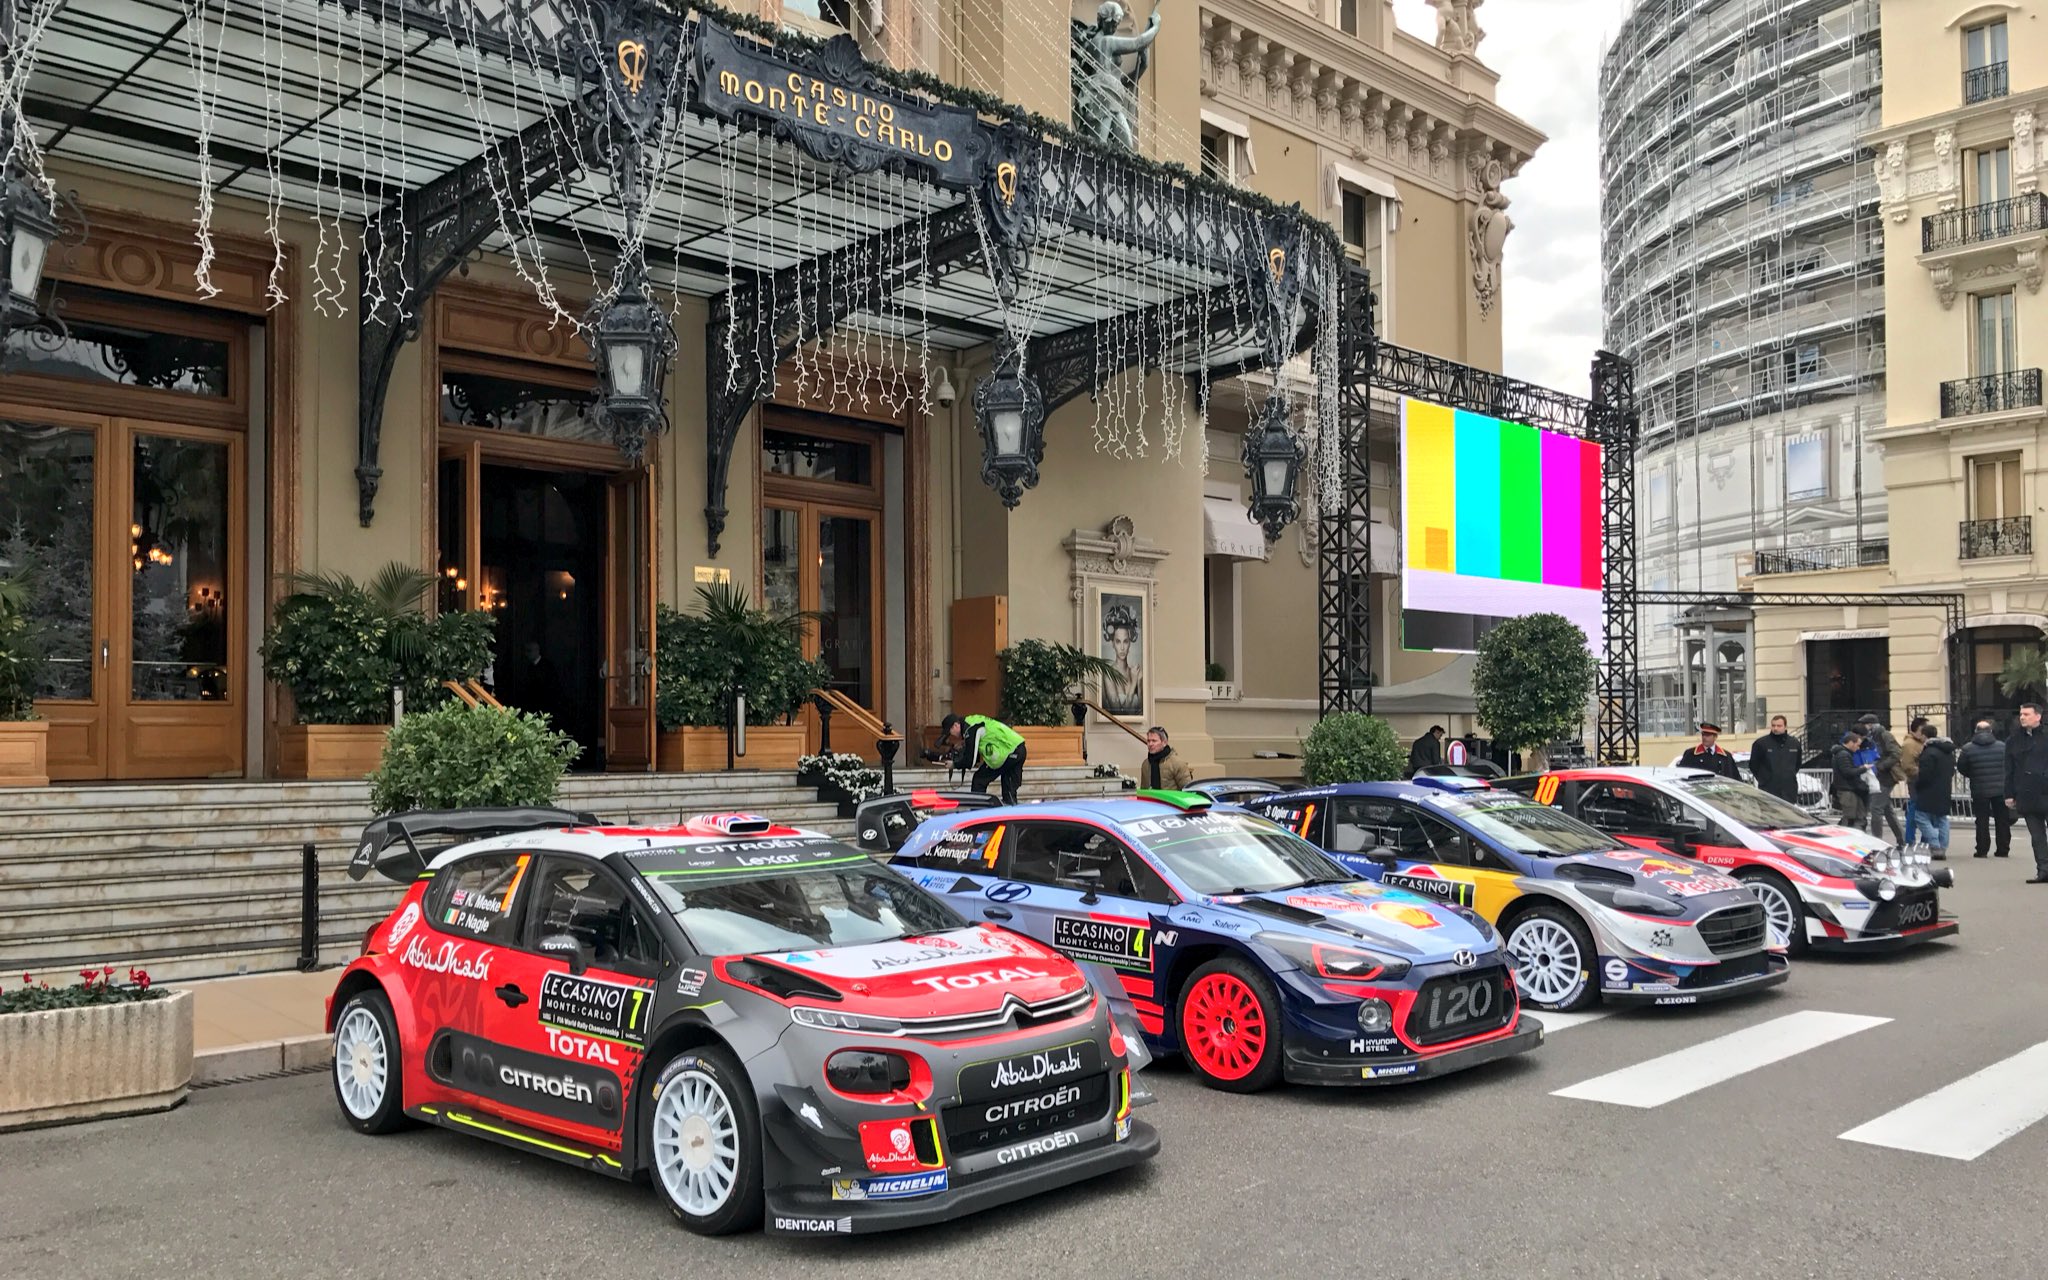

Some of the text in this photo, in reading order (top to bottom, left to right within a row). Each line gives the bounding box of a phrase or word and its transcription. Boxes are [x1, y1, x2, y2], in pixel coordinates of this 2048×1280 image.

[787, 73, 894, 123] CASINO
[720, 71, 953, 162] MONTE-CARLO
[1220, 541, 1263, 557] GRAFF
[1534, 775, 1559, 806] 10
[1265, 805, 1289, 820] S Ogier
[1300, 802, 1316, 840] 1
[931, 830, 973, 843] H. Paddon
[983, 824, 1007, 870] 4
[736, 853, 800, 867] Lexar
[925, 846, 970, 860] J. Kennard
[1707, 857, 1735, 865] DENSO
[501, 853, 532, 912] 7
[1399, 877, 1449, 895] CASINO
[465, 893, 502, 913] K. Meeke
[1458, 884, 1466, 906] 1
[457, 912, 490, 934] P. Nagle
[1056, 920, 1125, 942] LE CASINO
[543, 941, 575, 950] TOTAL
[1133, 929, 1145, 957] 4
[1088, 954, 1099, 962] Rally
[1099, 955, 1129, 966] Championship
[679, 967, 707, 987] C3
[912, 966, 1050, 992] TOTAL
[544, 976, 620, 1008] LE CASINO
[1655, 996, 1697, 1005] AZIONE
[629, 991, 644, 1030] 7
[1429, 978, 1493, 1030] i20
[564, 1017, 577, 1027] World
[577, 1020, 588, 1032] Rally
[588, 1022, 620, 1038] Championship
[545, 1026, 620, 1066] TOTAL
[1365, 1038, 1398, 1046] HYUNDAI
[661, 1057, 695, 1082] MICHELIN
[1377, 1064, 1416, 1075] MICHELIN
[979, 1109, 1076, 1140] RACING
[868, 1174, 945, 1193] MICHELIN
[775, 1217, 835, 1232] IDENTICAR
